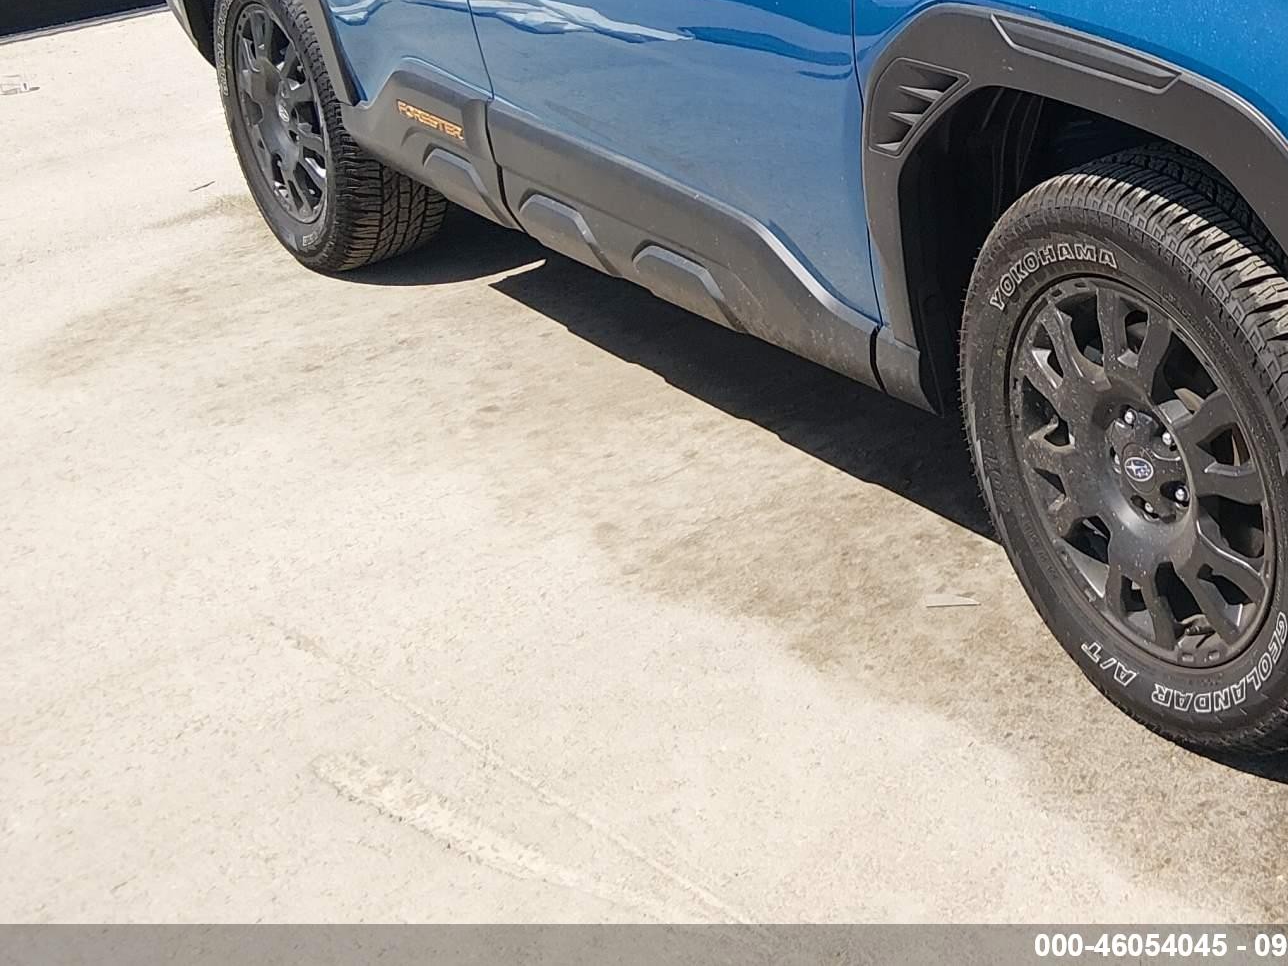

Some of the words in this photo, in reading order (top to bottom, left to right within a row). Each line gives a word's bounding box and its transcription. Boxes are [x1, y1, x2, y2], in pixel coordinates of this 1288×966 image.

[397, 100, 464, 140] FORESTER
[989, 242, 1118, 311] YOKOHAMA
[1080, 641, 1138, 687] A/T
[1151, 611, 1288, 714] GEOLANDAR
